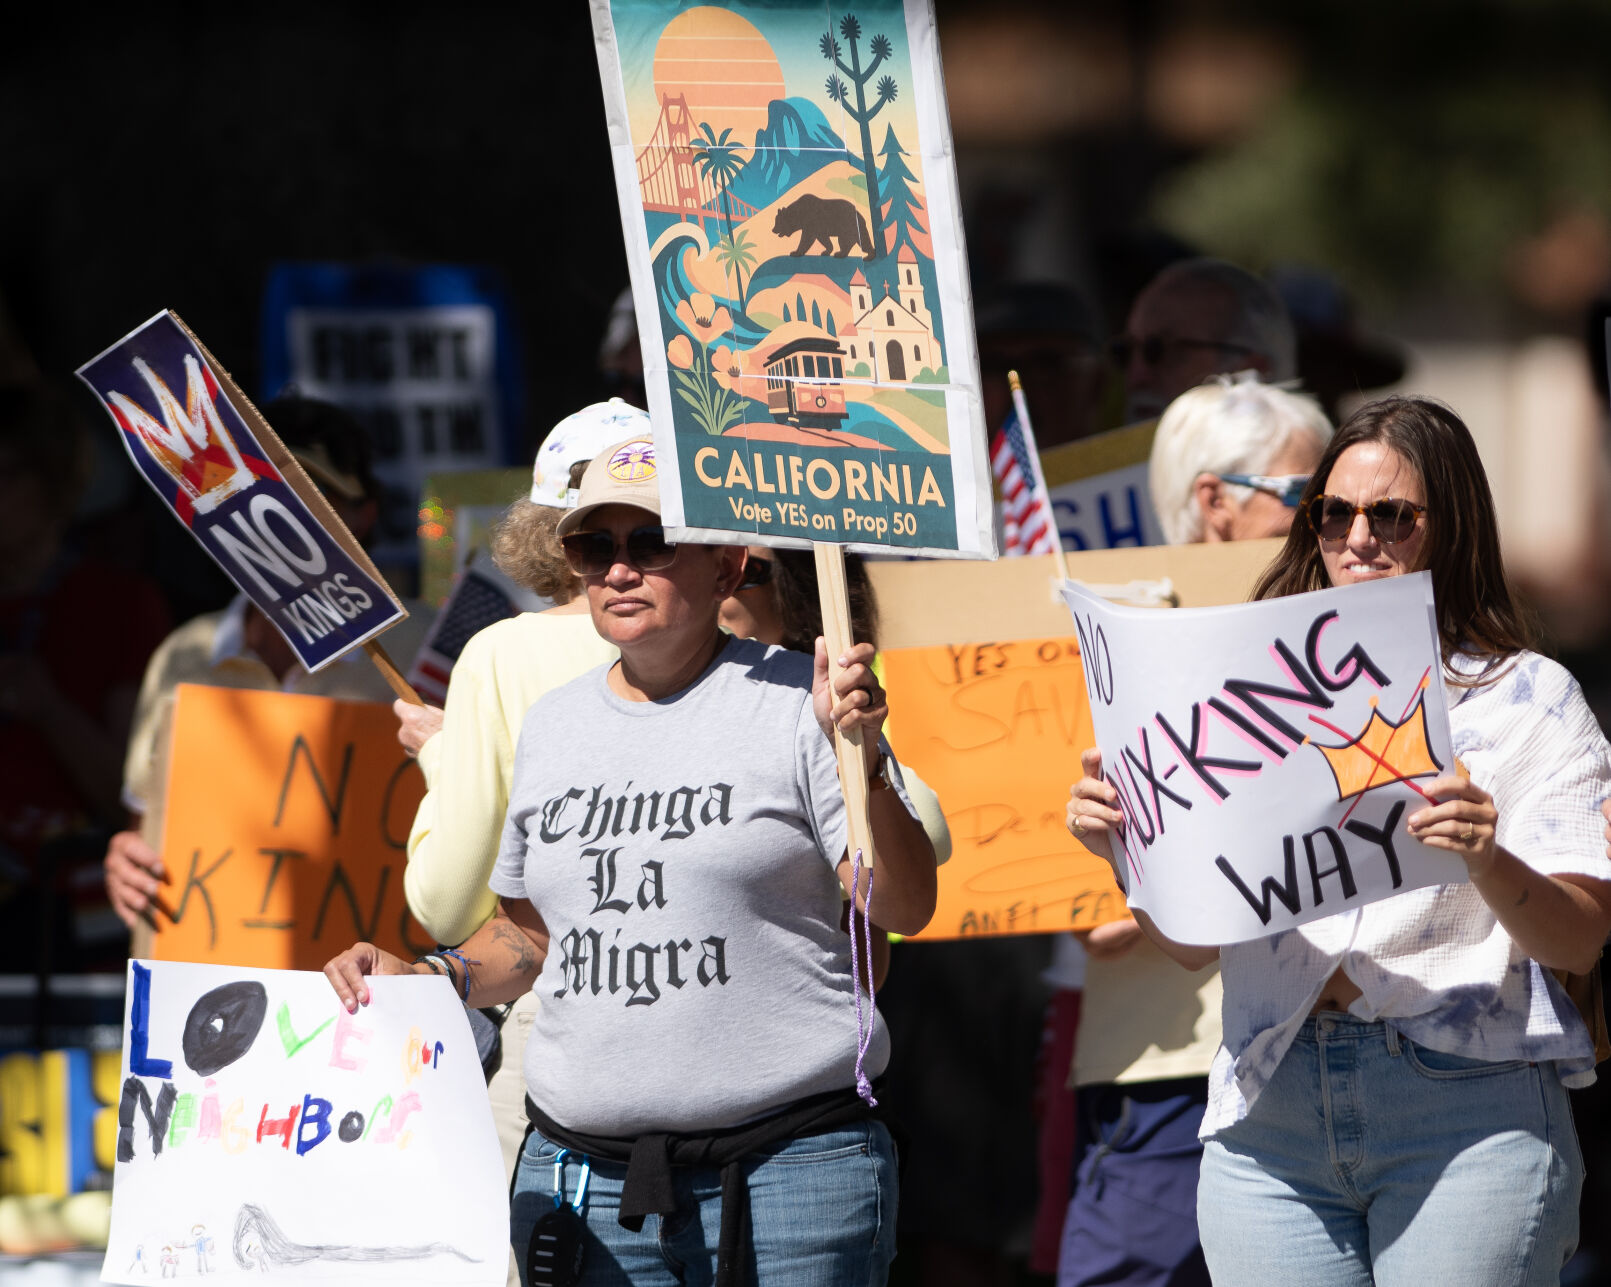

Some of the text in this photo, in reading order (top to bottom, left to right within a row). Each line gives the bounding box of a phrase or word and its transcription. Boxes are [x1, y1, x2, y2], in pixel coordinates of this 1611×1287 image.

[694, 446, 946, 508] CALIFORNIA
[208, 493, 328, 602] NO
[728, 496, 917, 540] Vote YES on Prop 50
[281, 572, 373, 645] KINGS
[947, 641, 1016, 684] YES
[1073, 611, 1114, 706] NO
[539, 780, 735, 848] Chinga
[579, 846, 669, 916] La
[1214, 799, 1407, 927] WAY
[553, 926, 732, 1008] Migra
[129, 959, 375, 1080] LOVE
